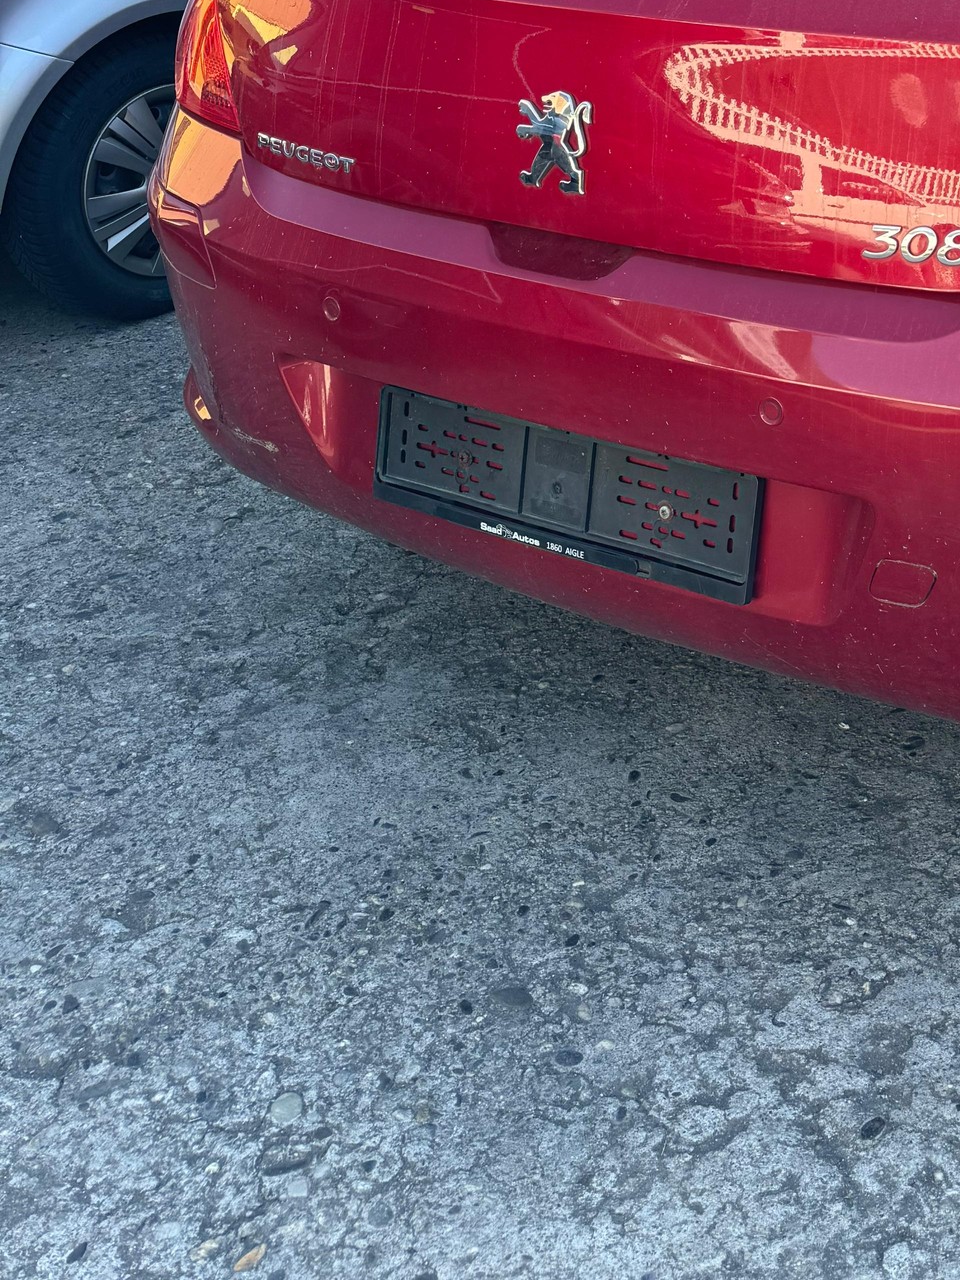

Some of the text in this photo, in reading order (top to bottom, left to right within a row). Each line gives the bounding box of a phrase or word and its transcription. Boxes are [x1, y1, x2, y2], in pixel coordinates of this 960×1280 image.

[257, 131, 356, 174] PEUGEOT
[480, 521, 585, 559] Saad Autos 1860 AIGLE
